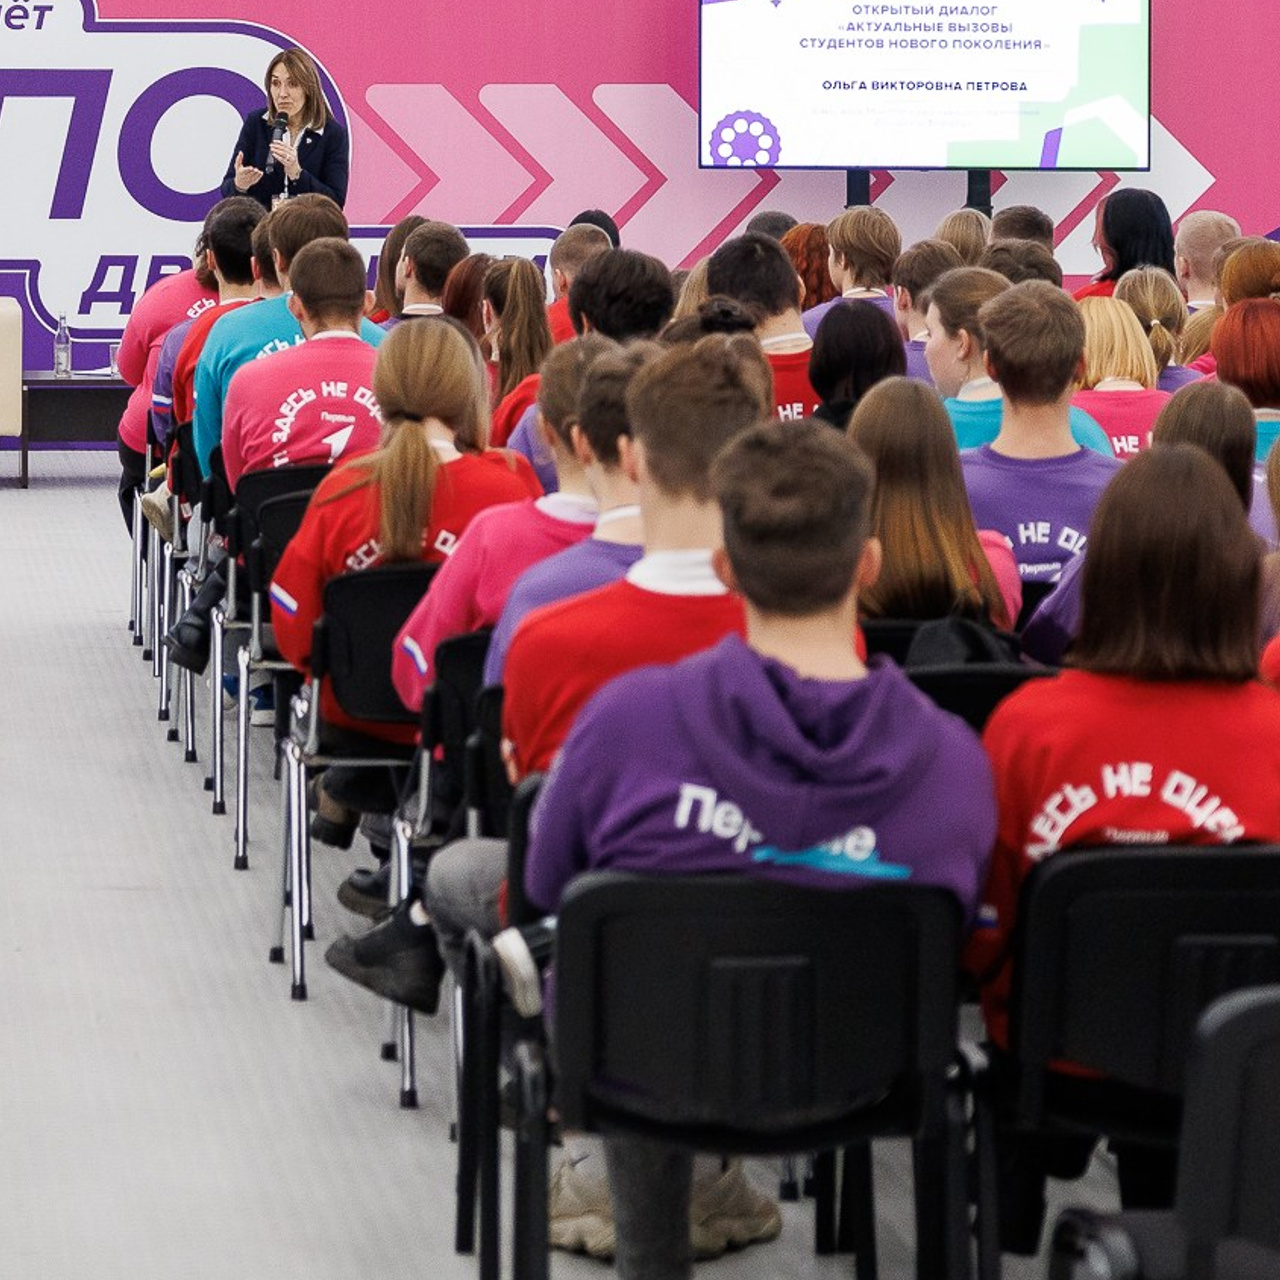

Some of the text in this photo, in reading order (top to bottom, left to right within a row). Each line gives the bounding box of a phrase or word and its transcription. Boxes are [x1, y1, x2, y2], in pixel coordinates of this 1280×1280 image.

[852, 3, 999, 17] ОТКРЫТЫЙ ДИАЛОГ
[948, 22, 1013, 33] ВЫЗОВЫ
[799, 37, 885, 50] СТУДЕНТОВ
[888, 38, 948, 50] НОВОГО
[822, 80, 1028, 91] ОЛЬГА ВИКТОРОВНА ПЕТРОВА
[321, 381, 348, 398] НЕ
[777, 402, 804, 422] НЕ
[1112, 435, 1139, 453] НЕ
[1018, 521, 1051, 544] НЕ
[1101, 761, 1154, 800] НЕ
